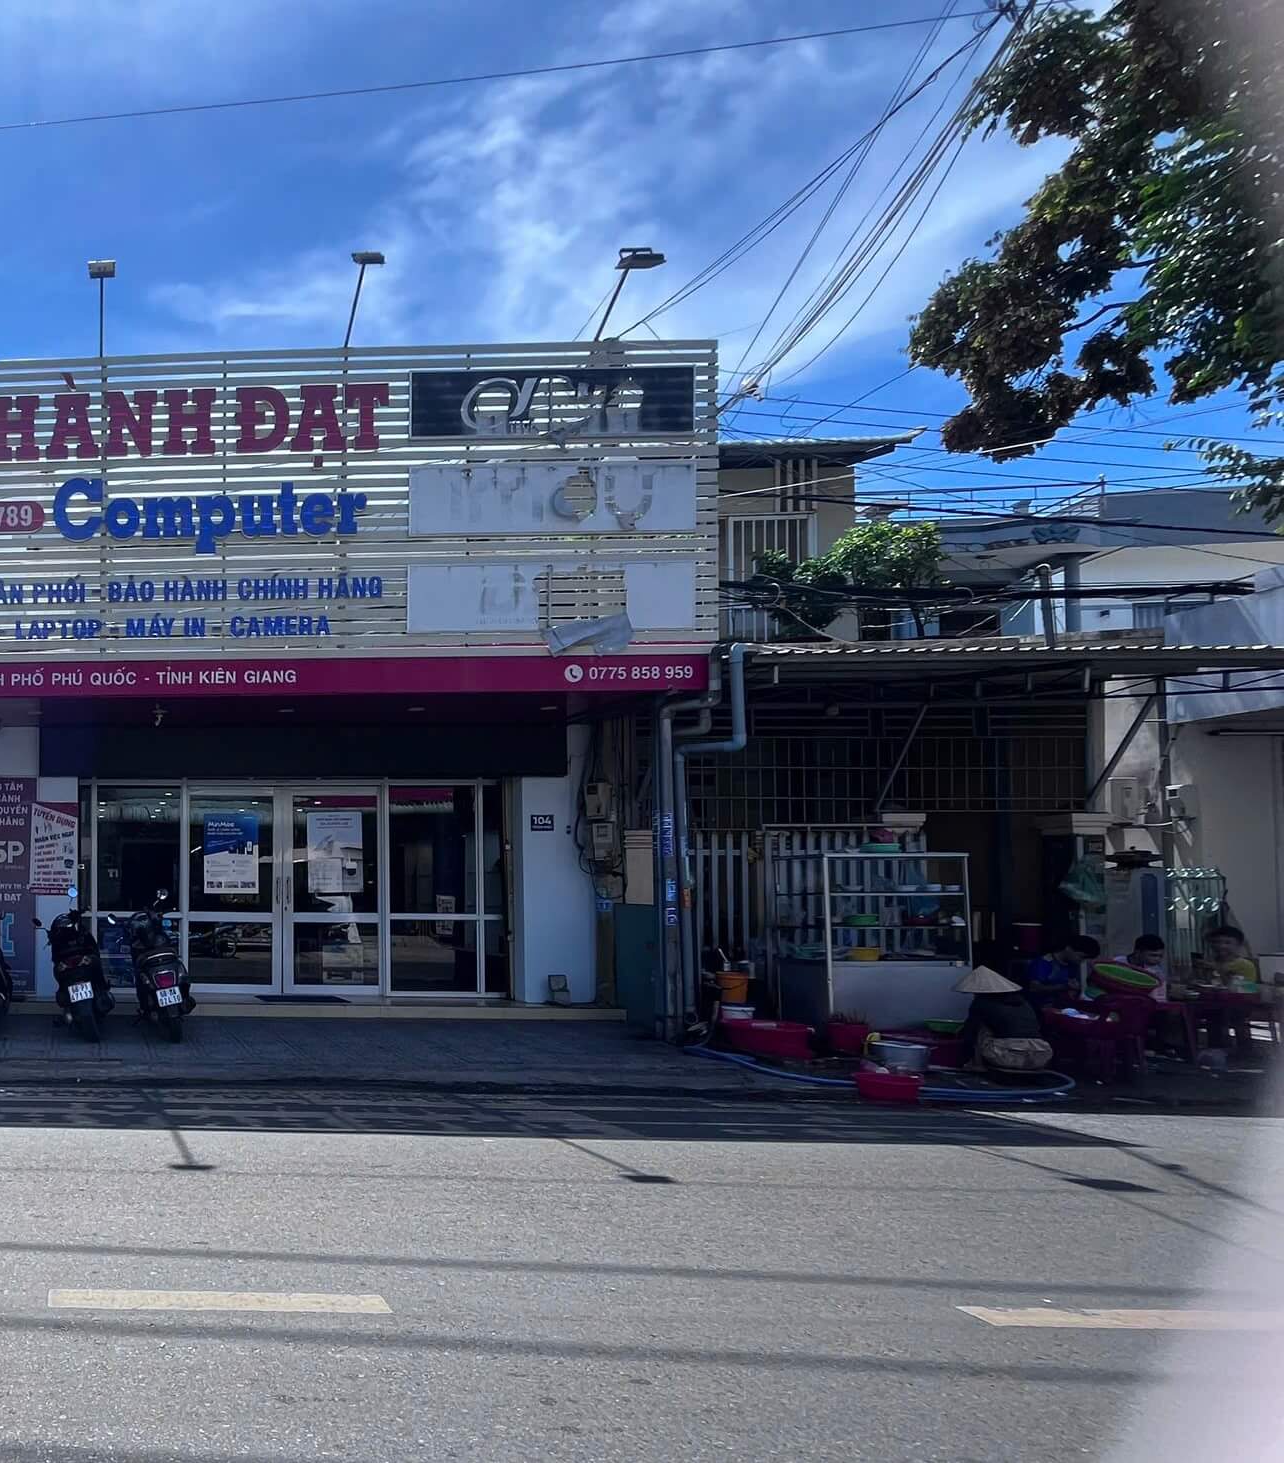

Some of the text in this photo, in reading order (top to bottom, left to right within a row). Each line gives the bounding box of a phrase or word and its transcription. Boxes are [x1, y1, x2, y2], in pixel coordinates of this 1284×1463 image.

[236, 383, 389, 470] ĐẠT
[53, 478, 367, 555] Computer
[32, 575, 86, 605] PHỐI
[108, 575, 155, 602] BẢO
[164, 576, 227, 602] HÀNH
[237, 572, 308, 600] CHÍNH
[319, 572, 382, 599] HÃNG
[16, 619, 102, 640] LAPTOP
[126, 613, 175, 637] MÁY
[183, 617, 206, 637] IN
[230, 615, 331, 638] CAMERA
[11, 667, 44, 686] PHỐ
[51, 669, 83, 685] PHÚ
[90, 667, 137, 685] QUỐC
[156, 667, 193, 684] TỈNH
[199, 668, 236, 684] KIÊN
[244, 671, 297, 684] GIANG
[589, 665, 693, 680] 0775 858 959
[532, 816, 552, 825] 104
